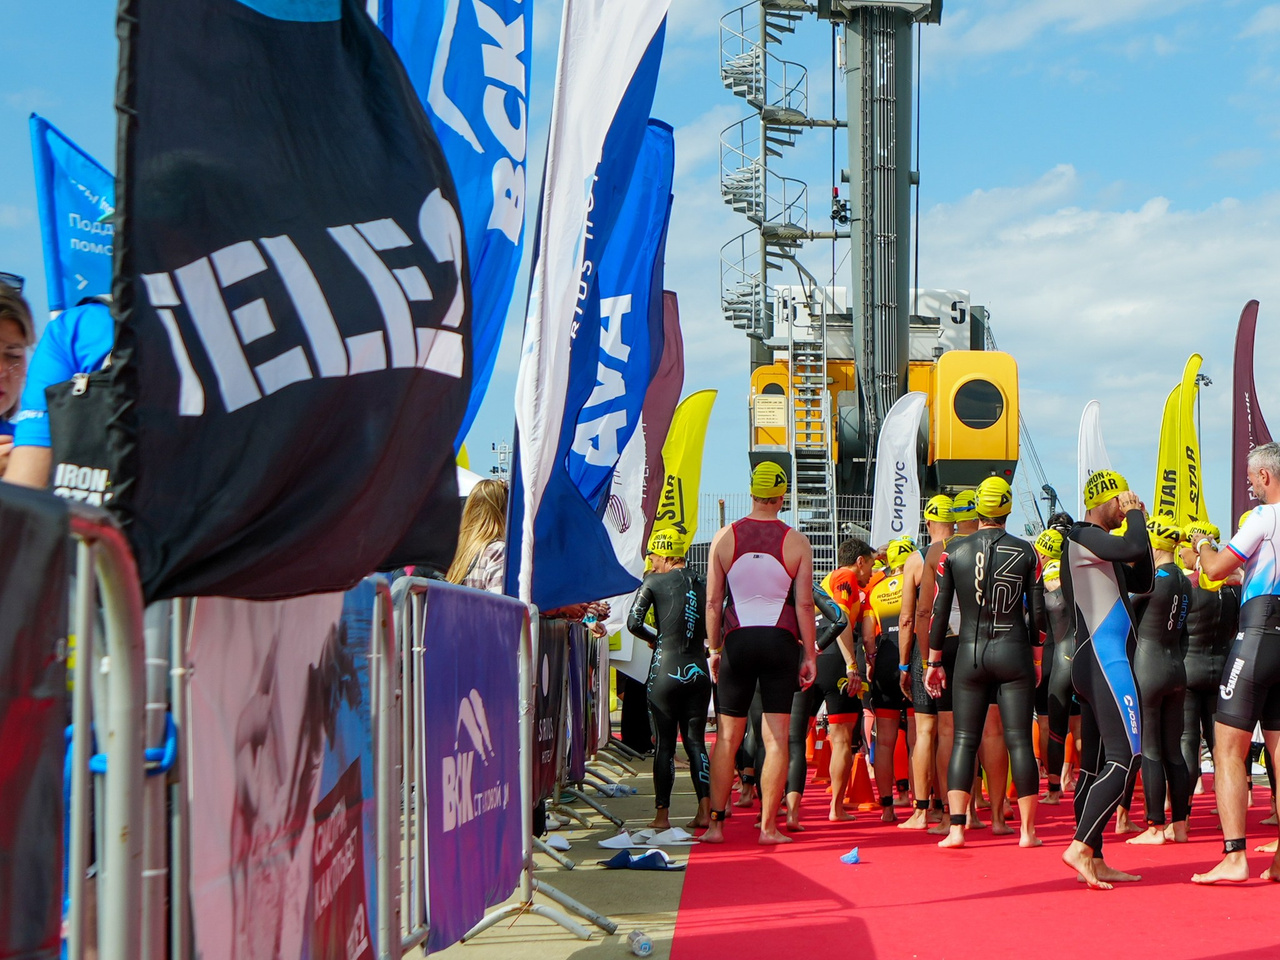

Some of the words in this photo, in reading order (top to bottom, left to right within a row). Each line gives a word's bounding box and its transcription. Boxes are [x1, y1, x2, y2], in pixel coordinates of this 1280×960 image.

[951, 300, 966, 325] 5
[54, 463, 109, 492] IRON
[1086, 471, 1106, 487] IRON
[1088, 478, 1118, 500] STAR
[891, 461, 908, 533] Сириус
[651, 540, 673, 551] STAR
[1036, 537, 1054, 553] STAR
[684, 589, 699, 639] sailfish
[1167, 594, 1179, 631] orca
